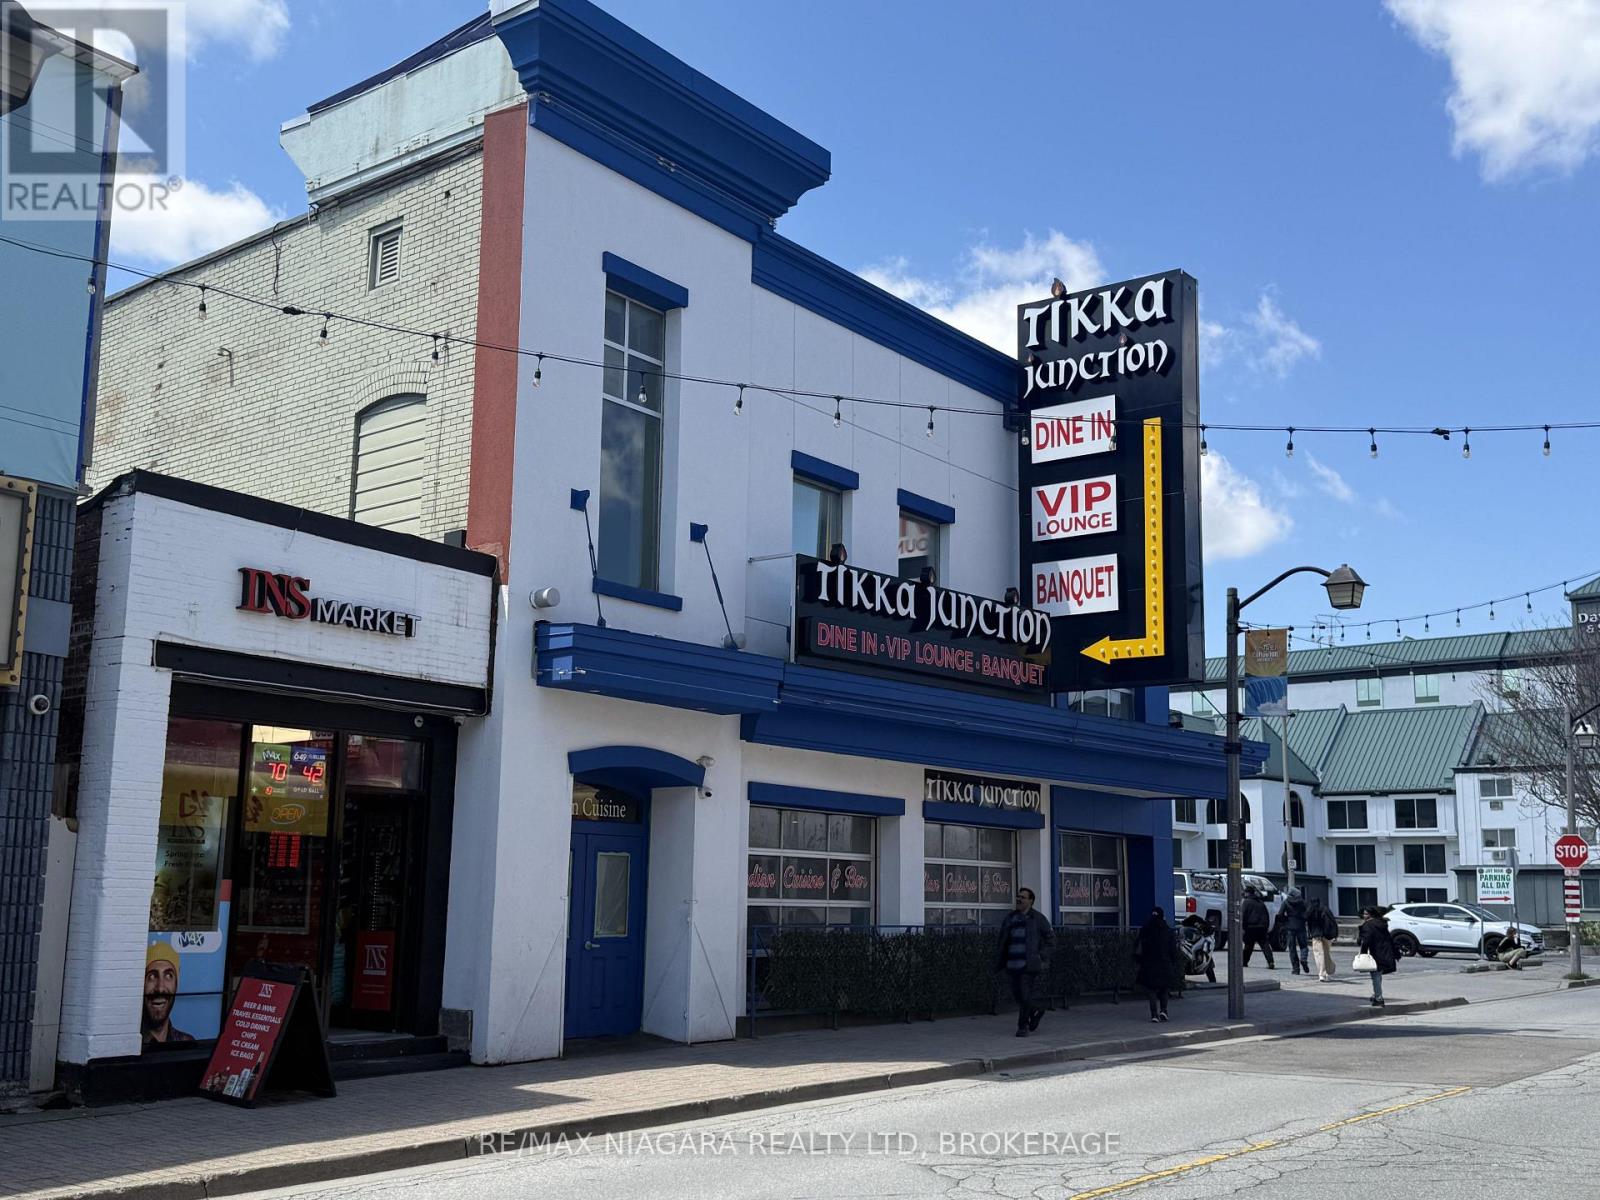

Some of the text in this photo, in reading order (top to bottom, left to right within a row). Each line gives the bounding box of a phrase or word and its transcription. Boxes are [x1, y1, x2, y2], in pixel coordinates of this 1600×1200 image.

[1035, 409, 1112, 451] DINE IN
[1036, 481, 1112, 517] VIP
[1037, 512, 1113, 537] LOUNGE
[1036, 565, 1114, 607] BANQUET
[236, 567, 422, 638] INS MARKET
[817, 622, 1045, 686] DINE IN VIP LOUNGE BANQUET
[303, 765, 324, 784] 42
[271, 806, 304, 821] OPEN
[583, 797, 626, 818] Cuisine
[1556, 845, 1587, 858] STOP
[1479, 874, 1511, 882] PARKING
[243, 1001, 257, 1010] BEER
[262, 1005, 277, 1013] WINE
[233, 1009, 281, 1024] TRAVEL ESSENTIALS
[235, 1019, 271, 1032] COLD DRINKS
[241, 1031, 257, 1040] CHIPS
[240, 1042, 260, 1050] CREAM
[240, 1051, 255, 1060] BAGS
